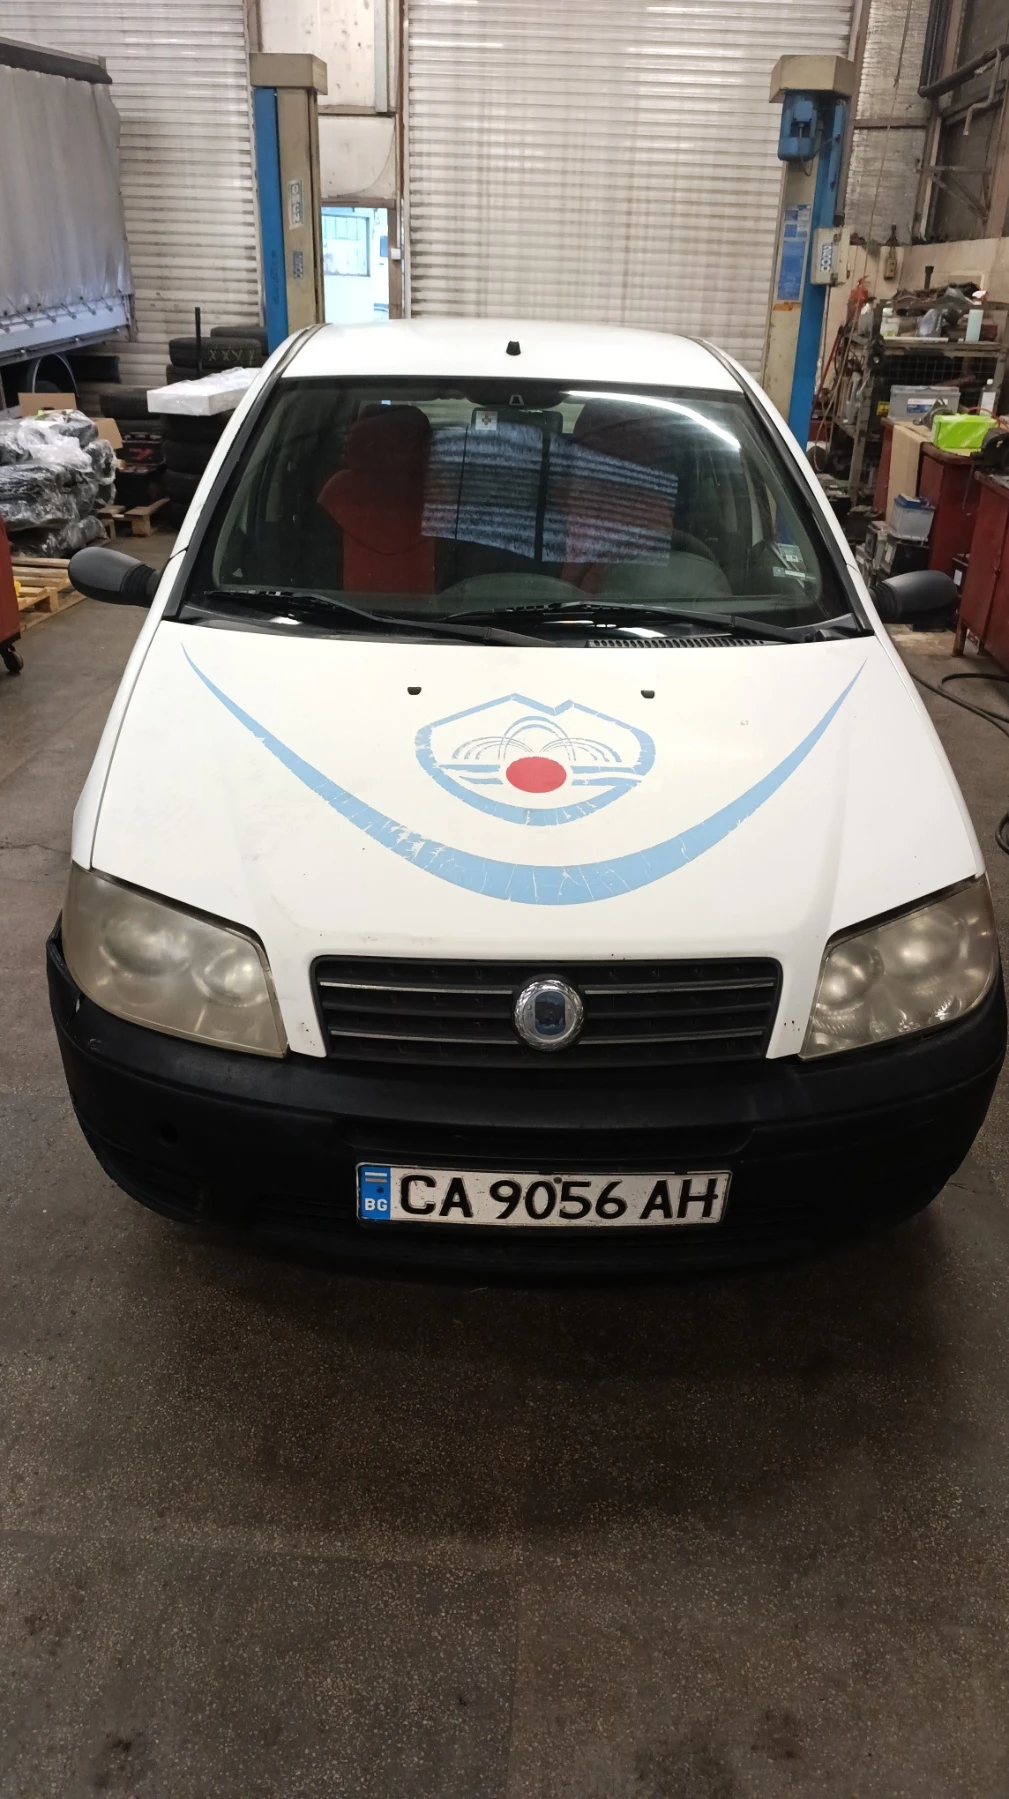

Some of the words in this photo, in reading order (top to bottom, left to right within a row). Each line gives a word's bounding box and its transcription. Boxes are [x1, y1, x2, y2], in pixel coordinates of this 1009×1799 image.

[364, 1198, 388, 1211] BG
[400, 1174, 474, 1218] CA
[489, 1180, 628, 1220] 9056
[639, 1178, 718, 1220] AH
